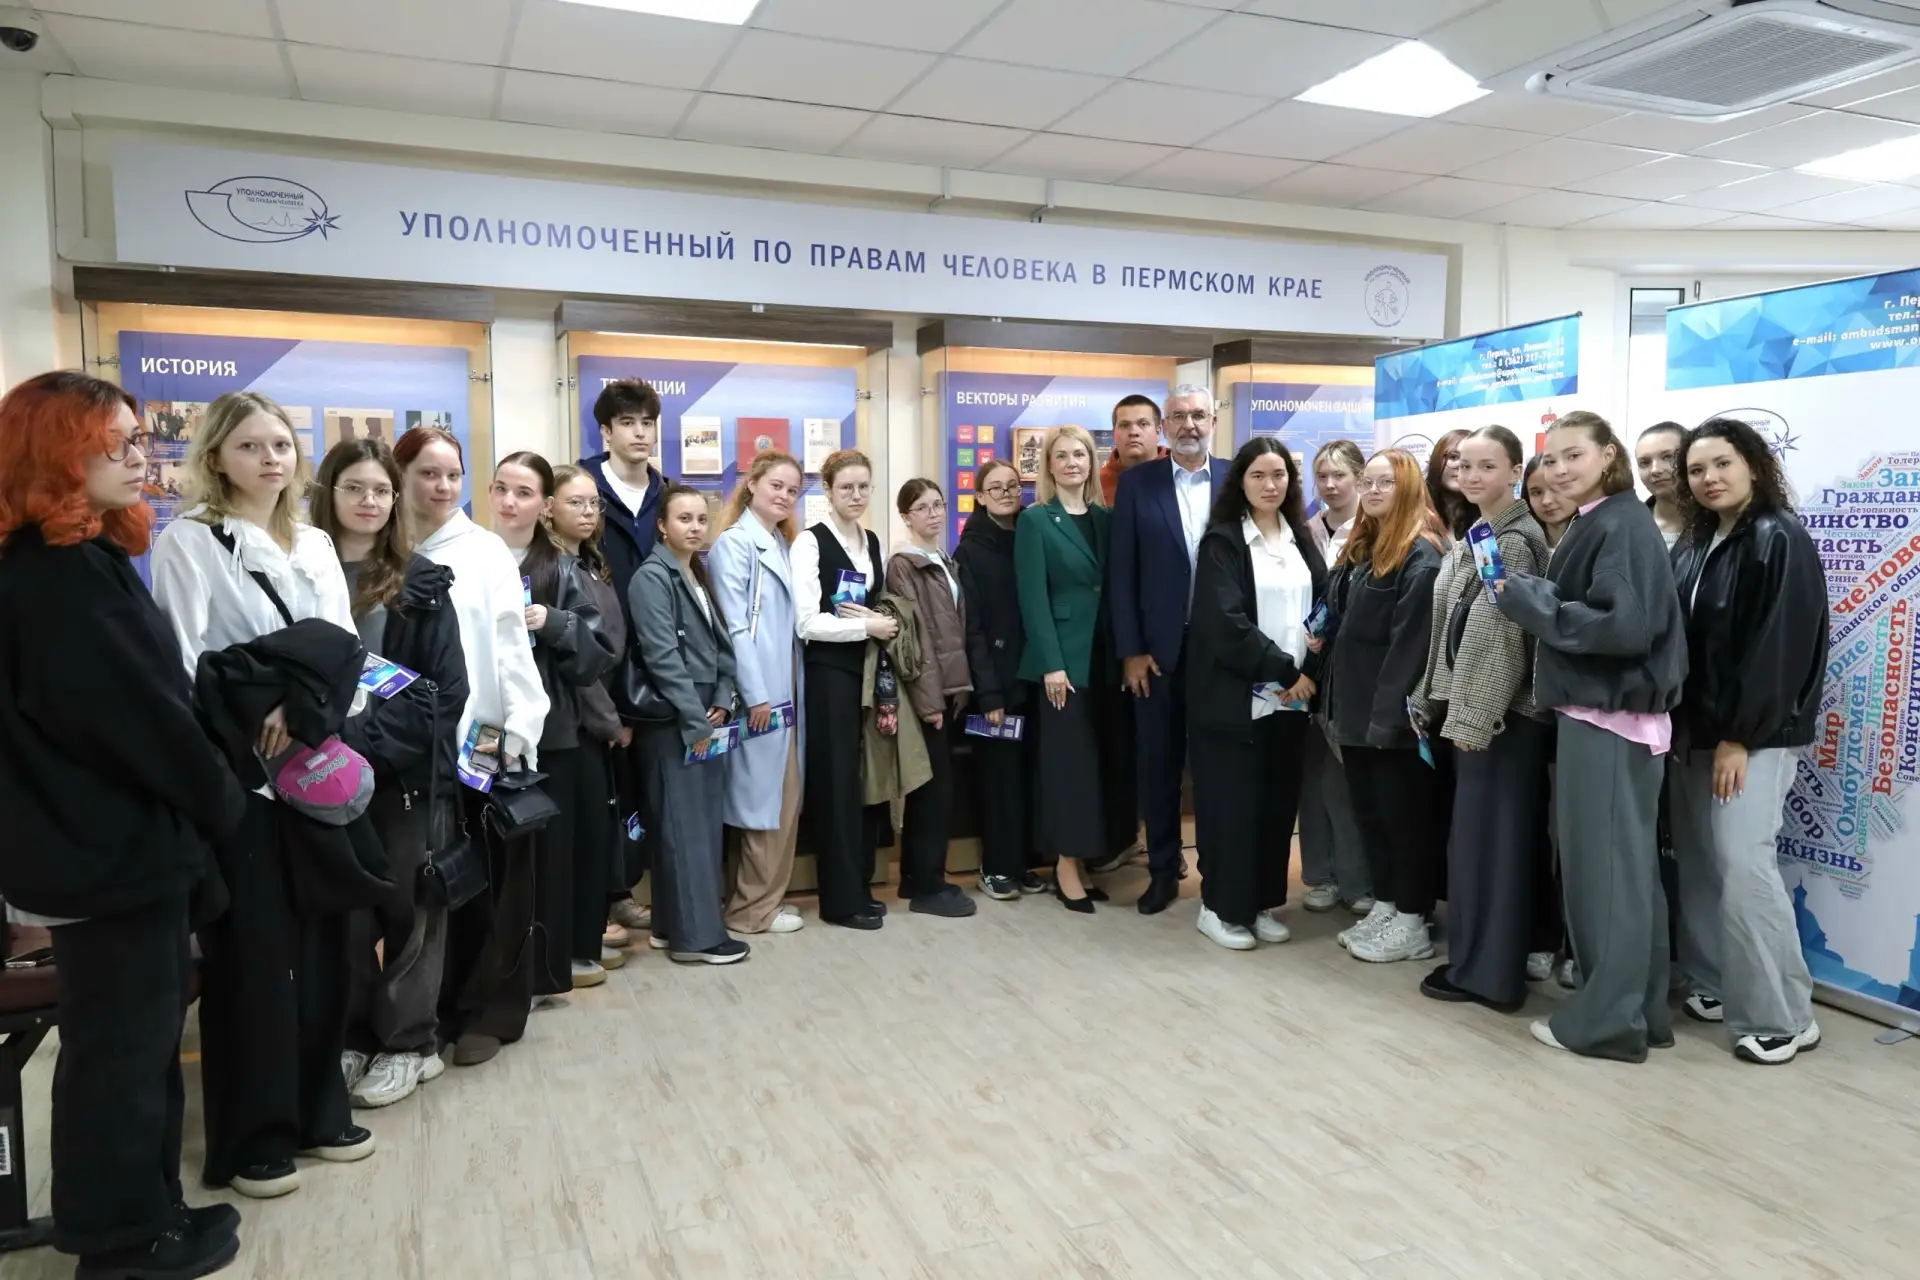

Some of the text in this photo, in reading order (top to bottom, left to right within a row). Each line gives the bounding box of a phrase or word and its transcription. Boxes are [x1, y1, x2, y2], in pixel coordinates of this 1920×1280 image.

[236, 187, 305, 200] УПОЛНОМОЧЕННЫЙ
[399, 210, 1323, 300] УПОЛНОМОЧЕННЫЙ ПО ПРАВАМ ЧЕЛОВЕКА В ПЕРМСКОМ КРАЕ
[1792, 323, 1919, 347] e-mail: ombudsman
[141, 357, 237, 377] ИСТОРИЯ
[600, 377, 686, 397] ТЦИИ
[956, 391, 1087, 408] ВЕКТОРЫ РАЗВИТИЯ
[1251, 399, 1332, 413] УПОЛНОМОЧЕН
[1858, 456, 1883, 481] Закон
[1841, 480, 1874, 489] Закон
[1821, 488, 1920, 508] Граждан
[1849, 506, 1919, 514] Безопасность
[1823, 529, 1883, 539] Честность
[1865, 615, 1889, 729] Личность
[1871, 598, 1907, 796] Безопасность
[1896, 708, 1906, 748] Доверие
[1818, 711, 1845, 772] Мир
[1837, 674, 1867, 836] Омбудсмен
[1865, 730, 1876, 778] Личность
[1854, 793, 1870, 856] Совесть
